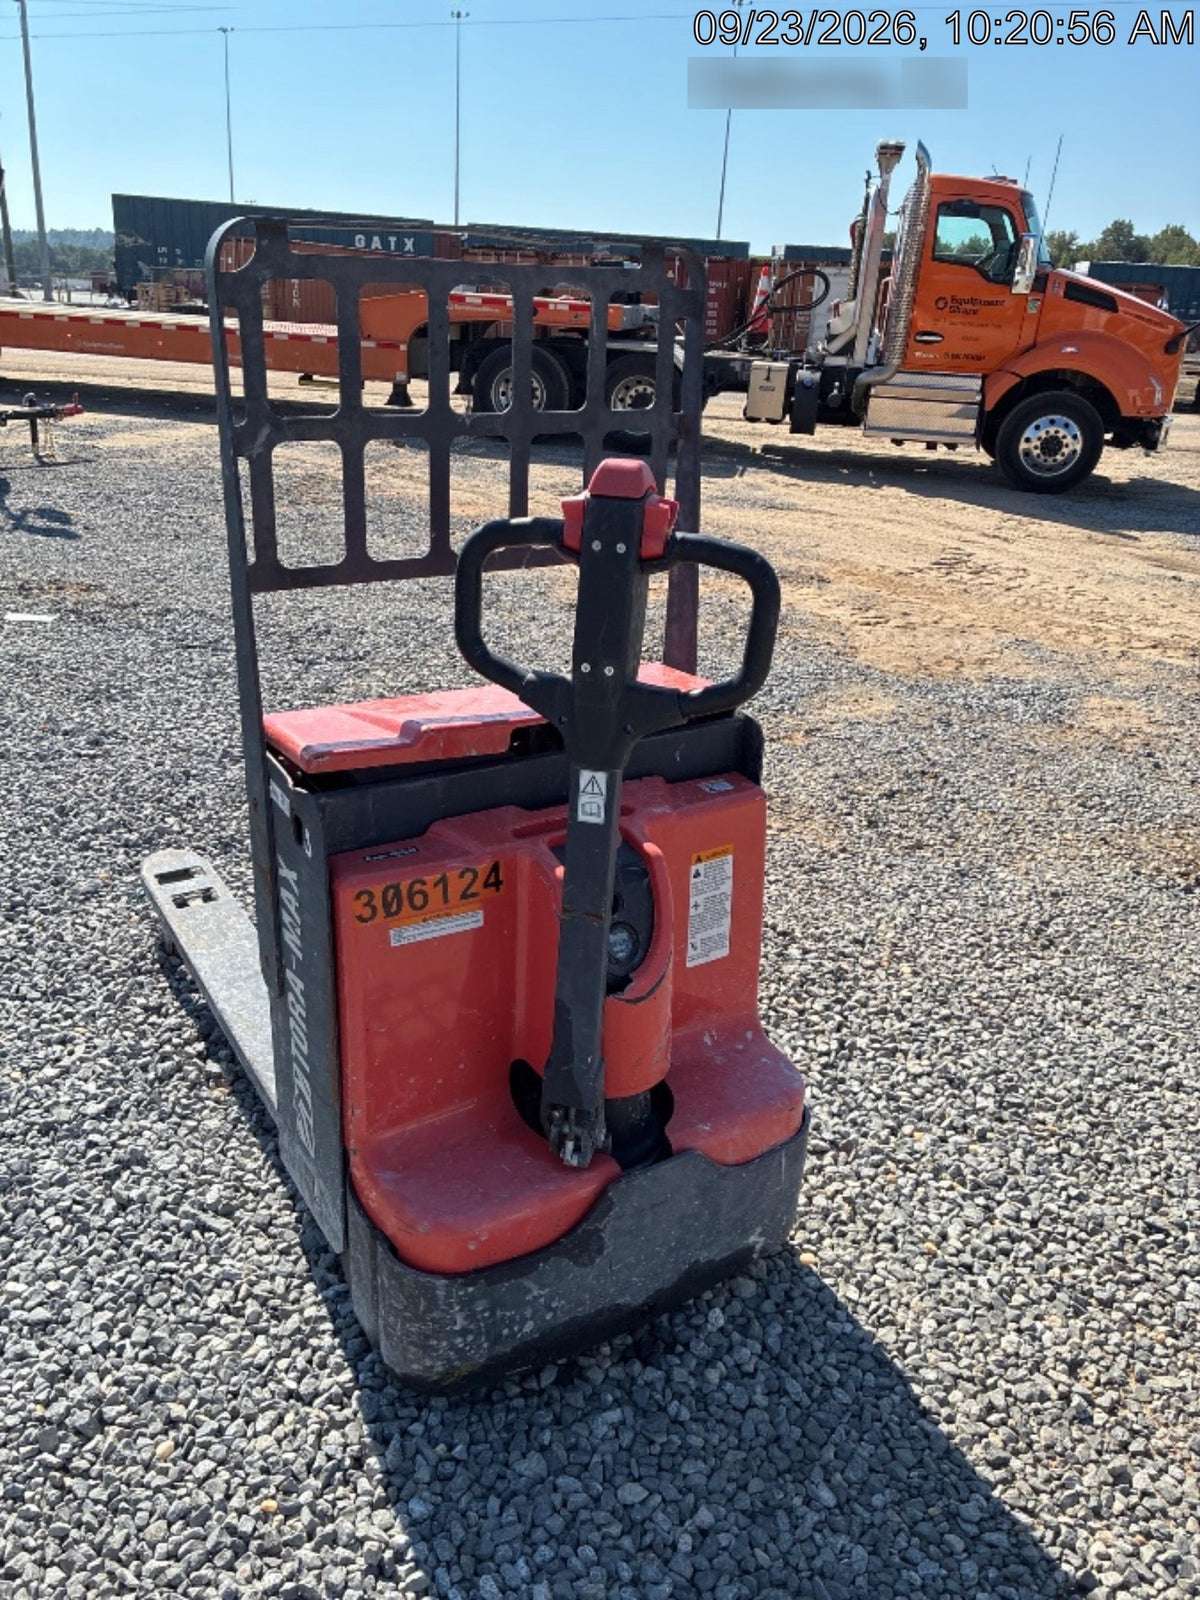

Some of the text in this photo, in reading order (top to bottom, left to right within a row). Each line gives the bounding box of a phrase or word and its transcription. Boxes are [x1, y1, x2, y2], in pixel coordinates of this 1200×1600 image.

[354, 234, 415, 252] GATX
[354, 861, 504, 924] 306124
[277, 853, 311, 1074] TORA-MAX
